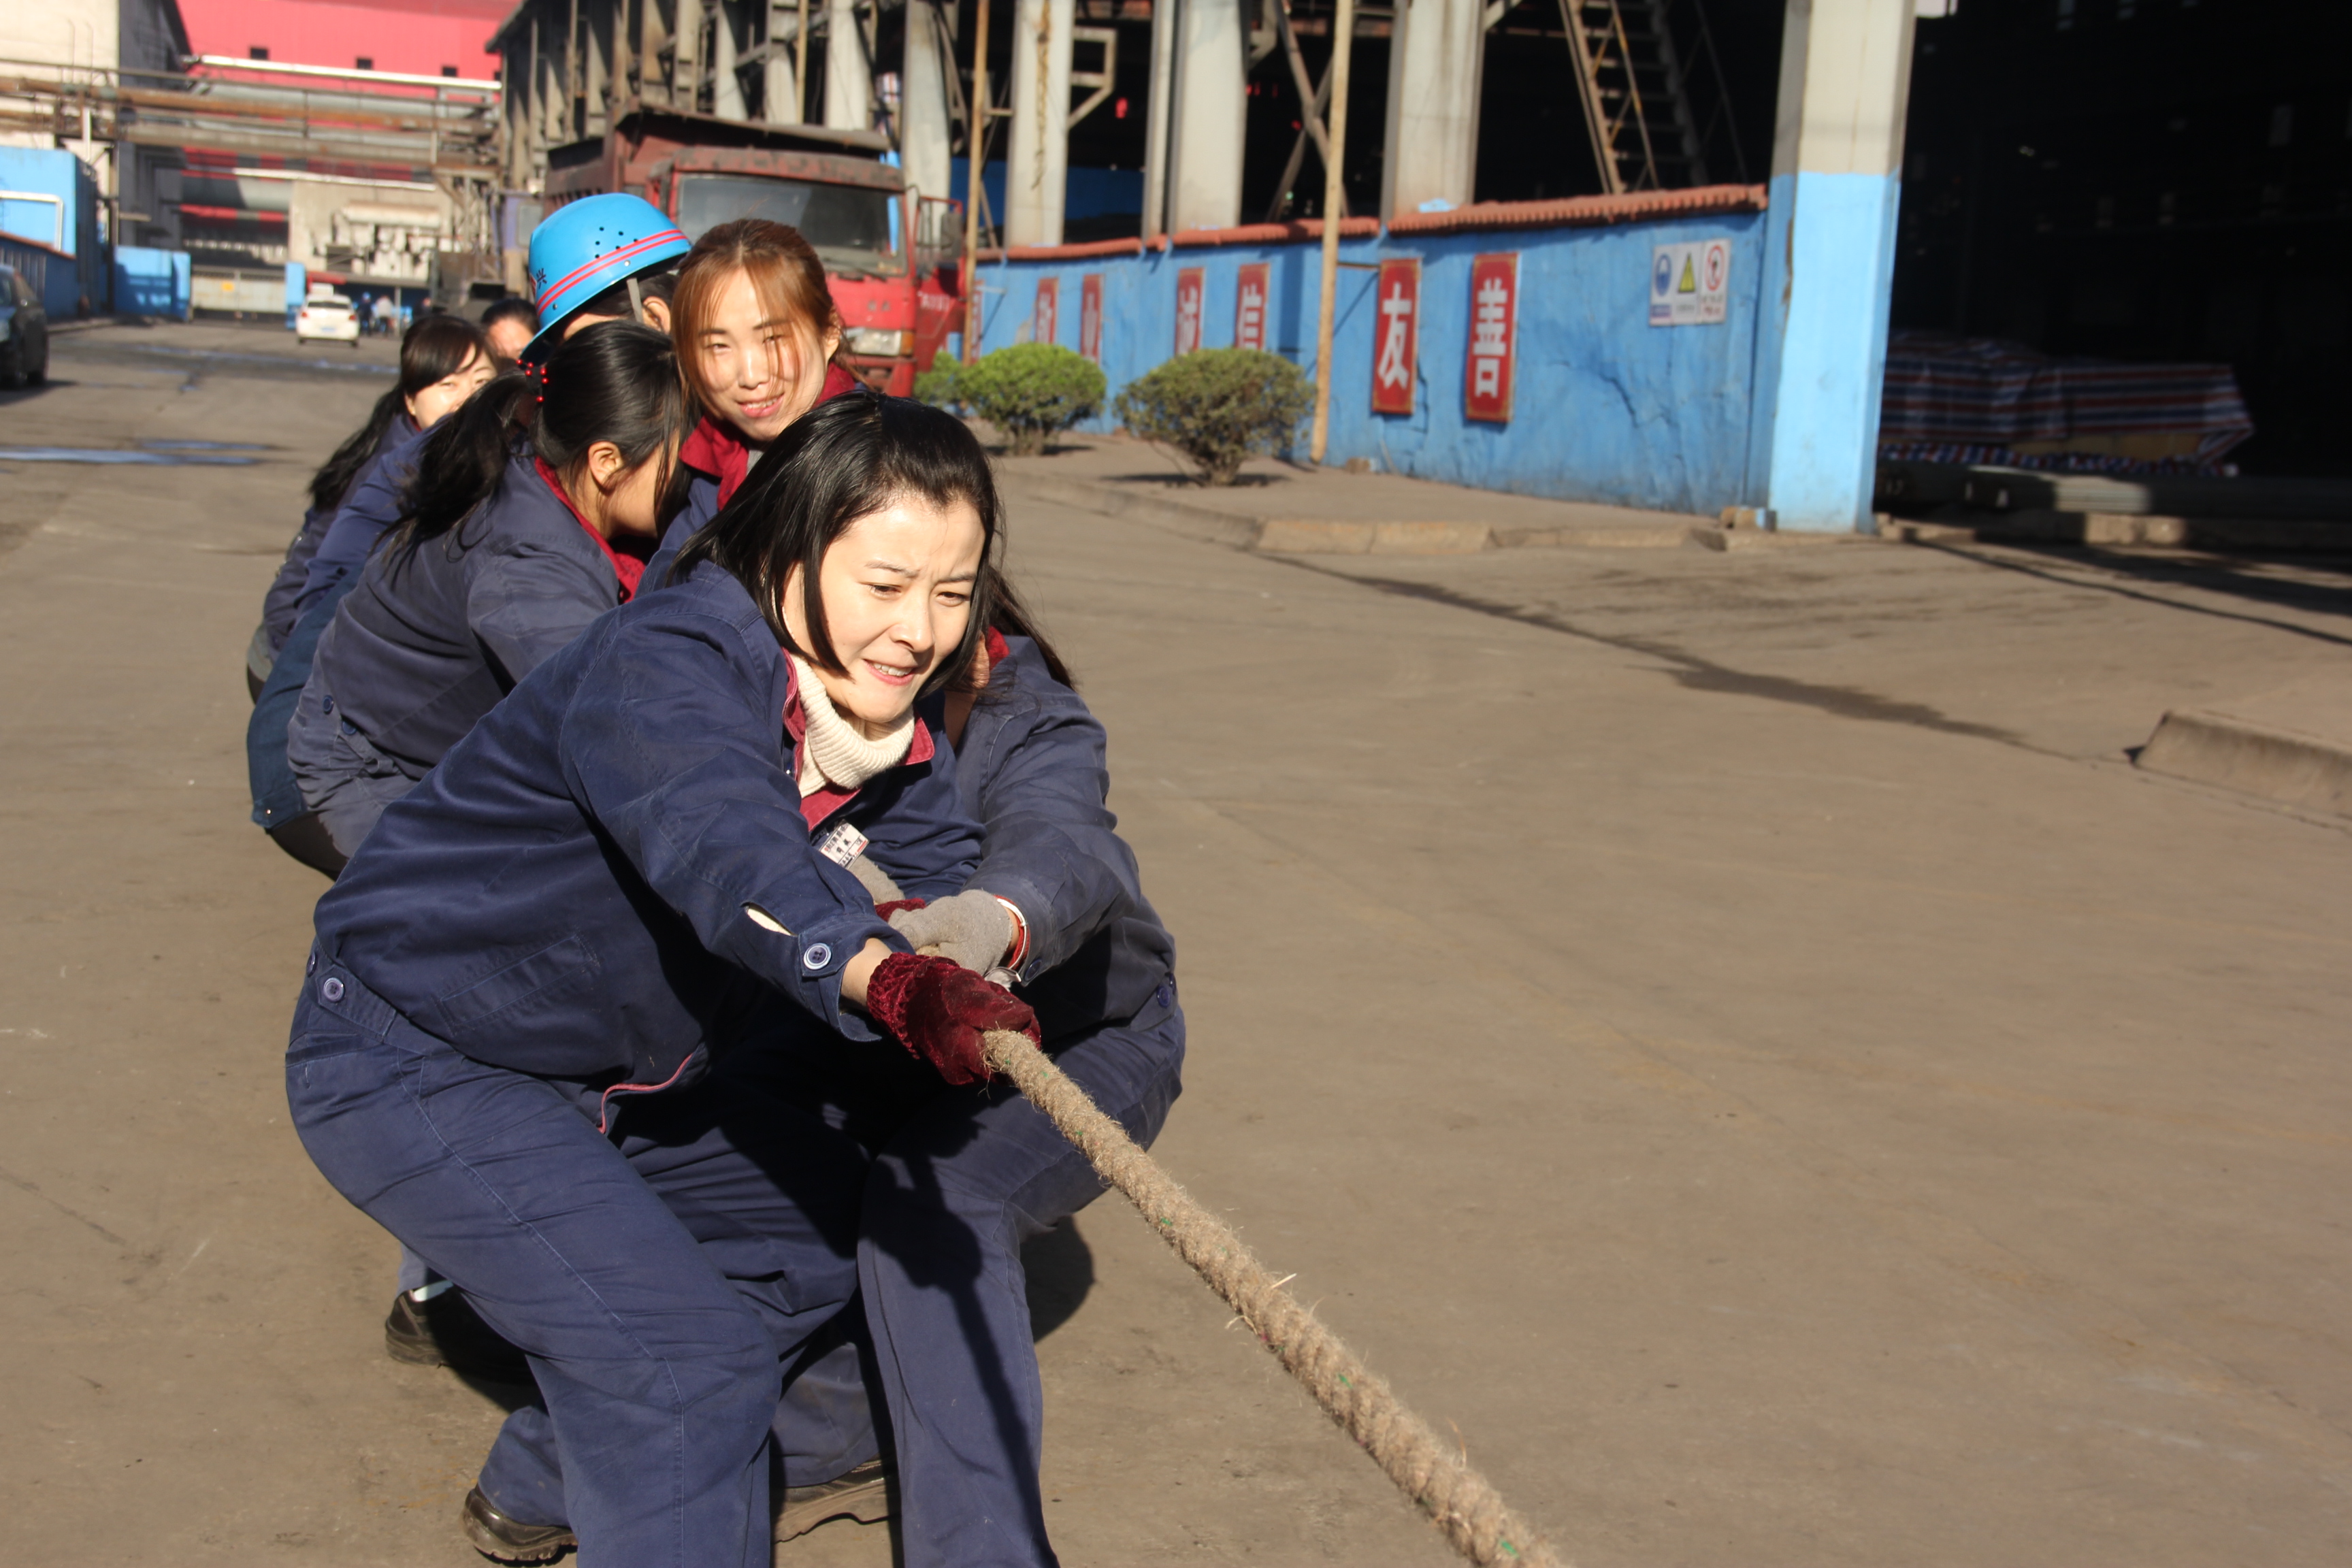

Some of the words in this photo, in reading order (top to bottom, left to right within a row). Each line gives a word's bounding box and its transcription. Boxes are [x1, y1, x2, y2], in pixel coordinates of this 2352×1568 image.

[536, 267, 548, 290] 兴
[1377, 281, 1413, 390] 友
[1472, 278, 1508, 399] 善
